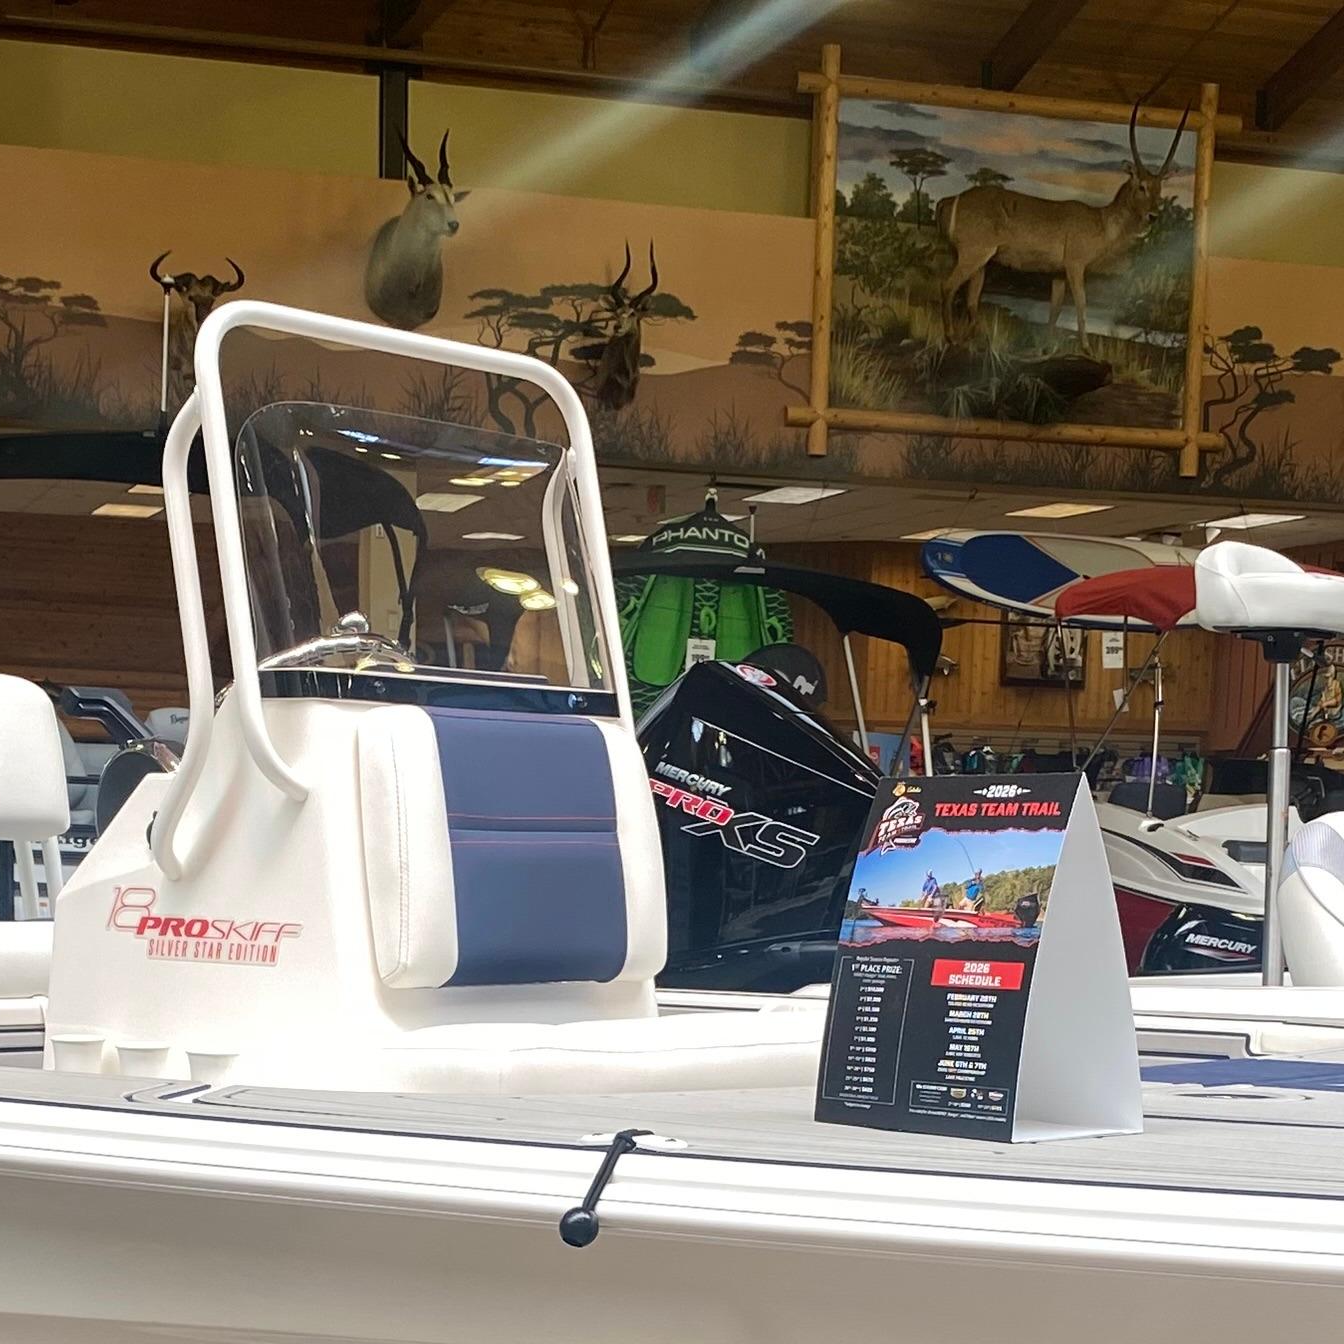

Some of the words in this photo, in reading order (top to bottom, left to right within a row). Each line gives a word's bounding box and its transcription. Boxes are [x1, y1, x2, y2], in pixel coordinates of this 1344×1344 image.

[655, 762, 732, 797] MERCURY
[649, 778, 734, 826] PRO
[986, 785, 1018, 798] 2026
[935, 802, 978, 816] TEXAS
[980, 802, 1018, 816] TEAM
[1021, 802, 1061, 816] TRAIL
[878, 815, 923, 838] TEXAS
[680, 812, 820, 868] XS
[106, 887, 156, 931] 18
[136, 916, 303, 942] PROSKIFF
[148, 939, 188, 958] SILVER
[193, 941, 222, 960] STAR
[228, 942, 278, 963] EDITION
[1185, 933, 1256, 954] MERCURY
[860, 964, 881, 973] PLACE
[963, 962, 991, 974] 2026
[948, 974, 1002, 987] SCHEDULE
